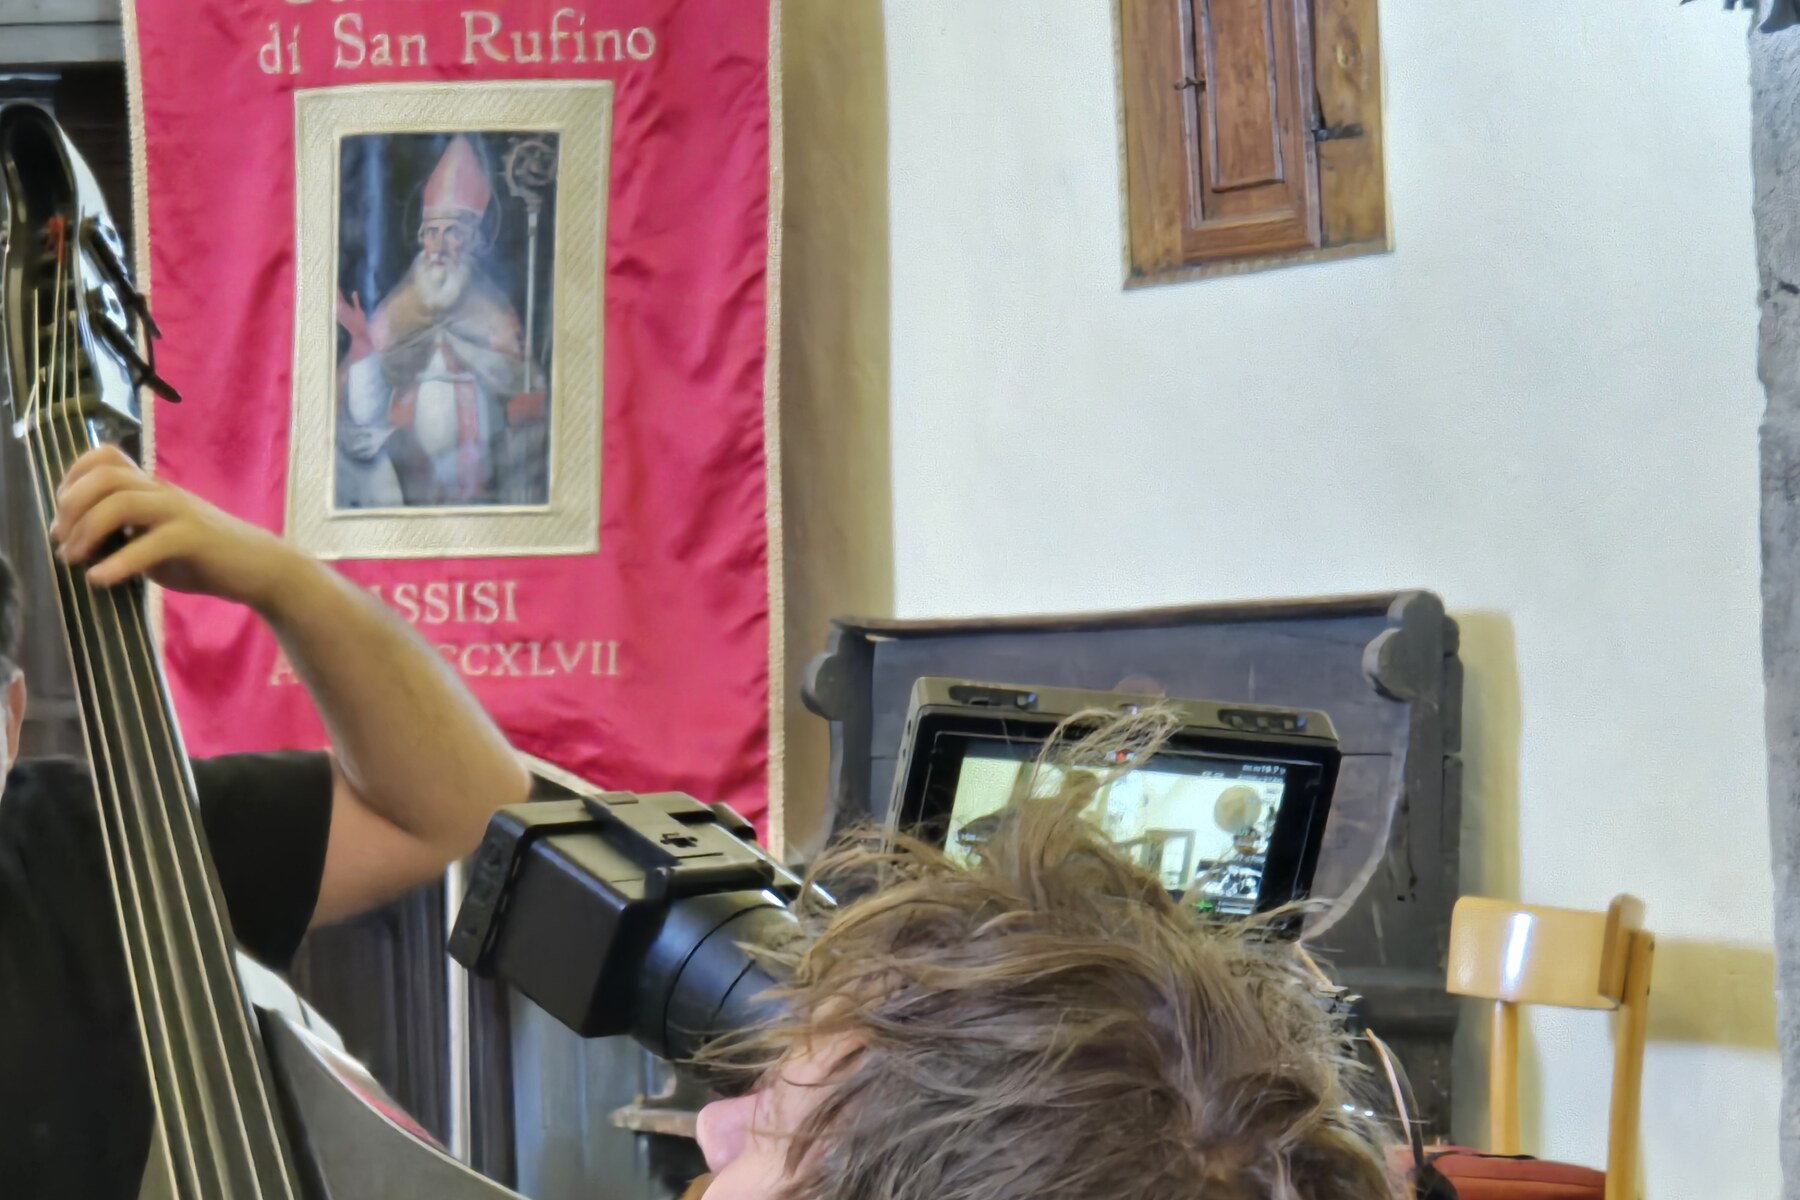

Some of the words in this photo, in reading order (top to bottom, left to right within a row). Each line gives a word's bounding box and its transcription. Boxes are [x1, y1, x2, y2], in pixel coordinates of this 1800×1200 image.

[258, 21, 303, 75] di
[333, 12, 428, 69] San
[460, 7, 656, 65] Rufino
[368, 580, 519, 625] SSISI
